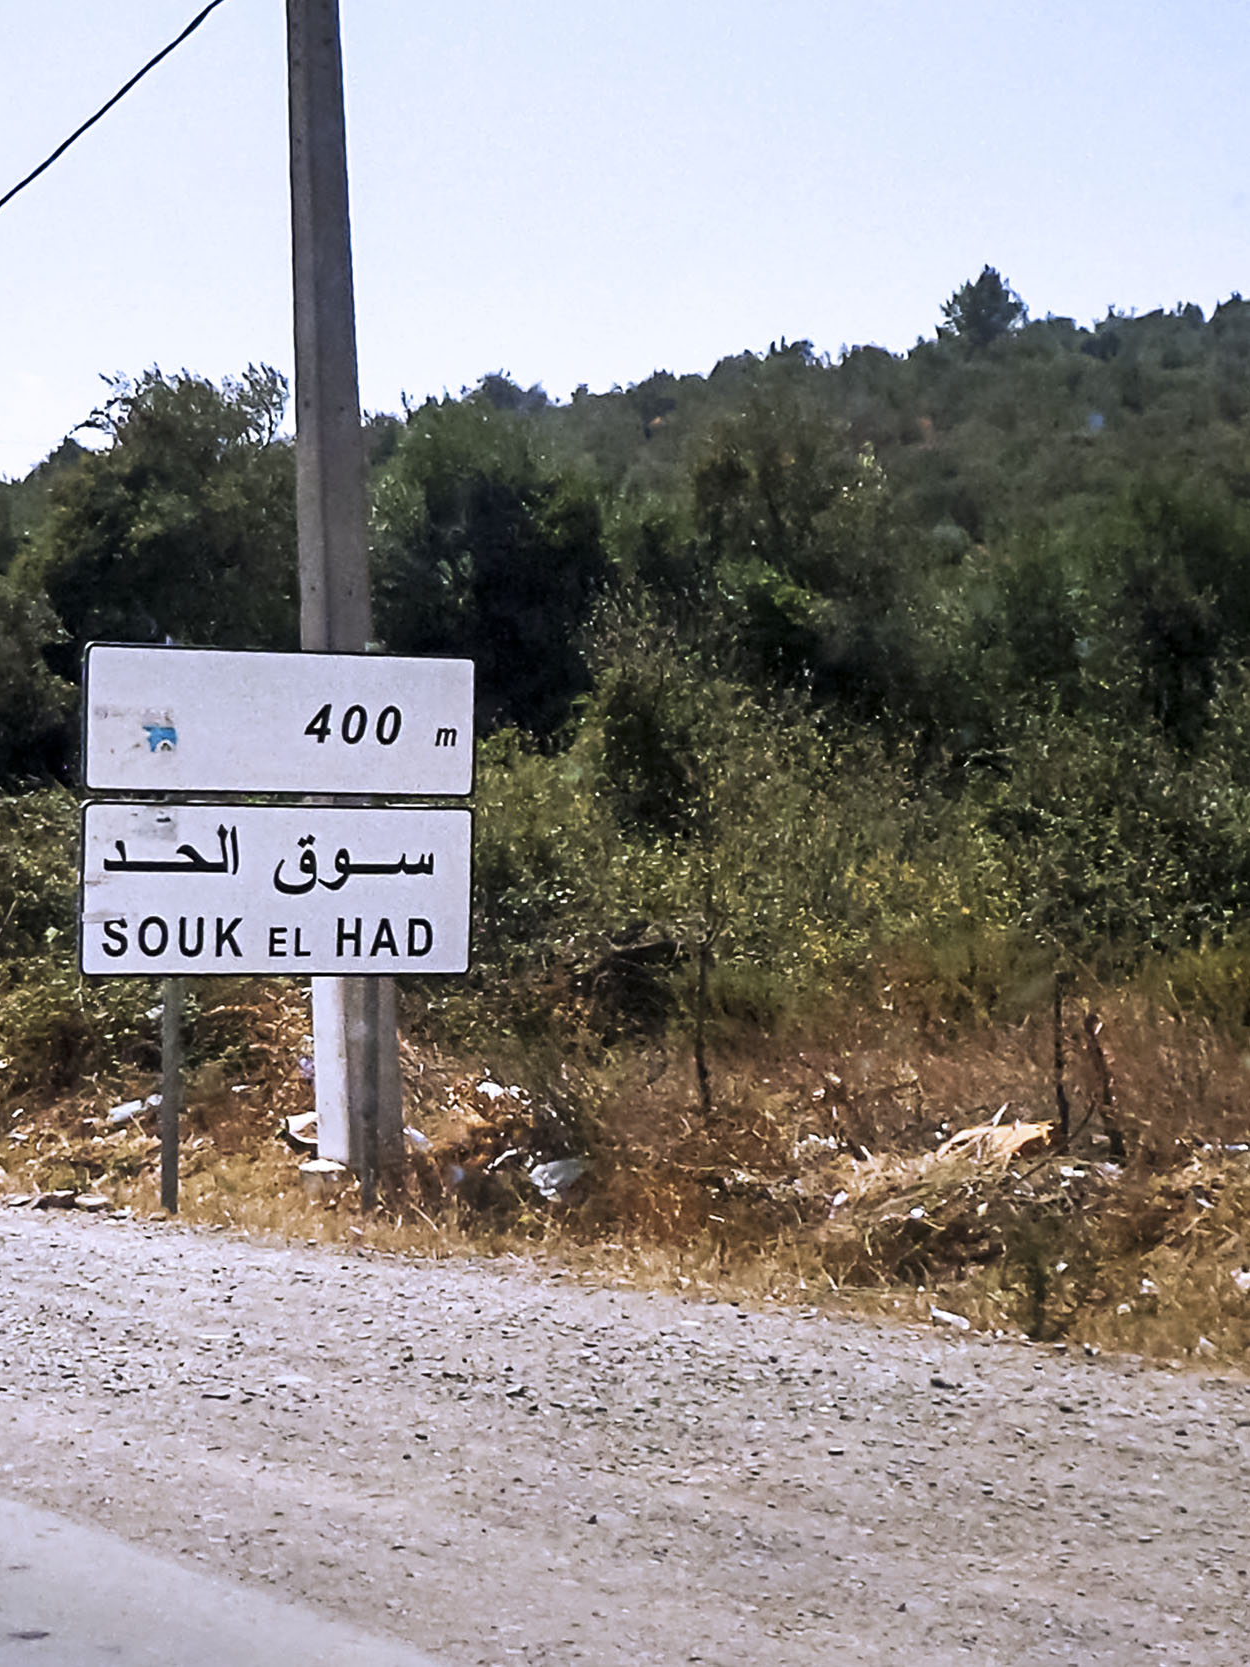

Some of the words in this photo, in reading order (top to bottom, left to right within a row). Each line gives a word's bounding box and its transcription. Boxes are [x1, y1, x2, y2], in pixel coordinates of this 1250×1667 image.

[303, 703, 402, 747] 400
[434, 727, 458, 747] m
[102, 823, 240, 876] الحد
[273, 834, 435, 895] سوق
[101, 916, 244, 958] SOUK
[268, 926, 312, 958] EL
[336, 917, 434, 958] HAD
